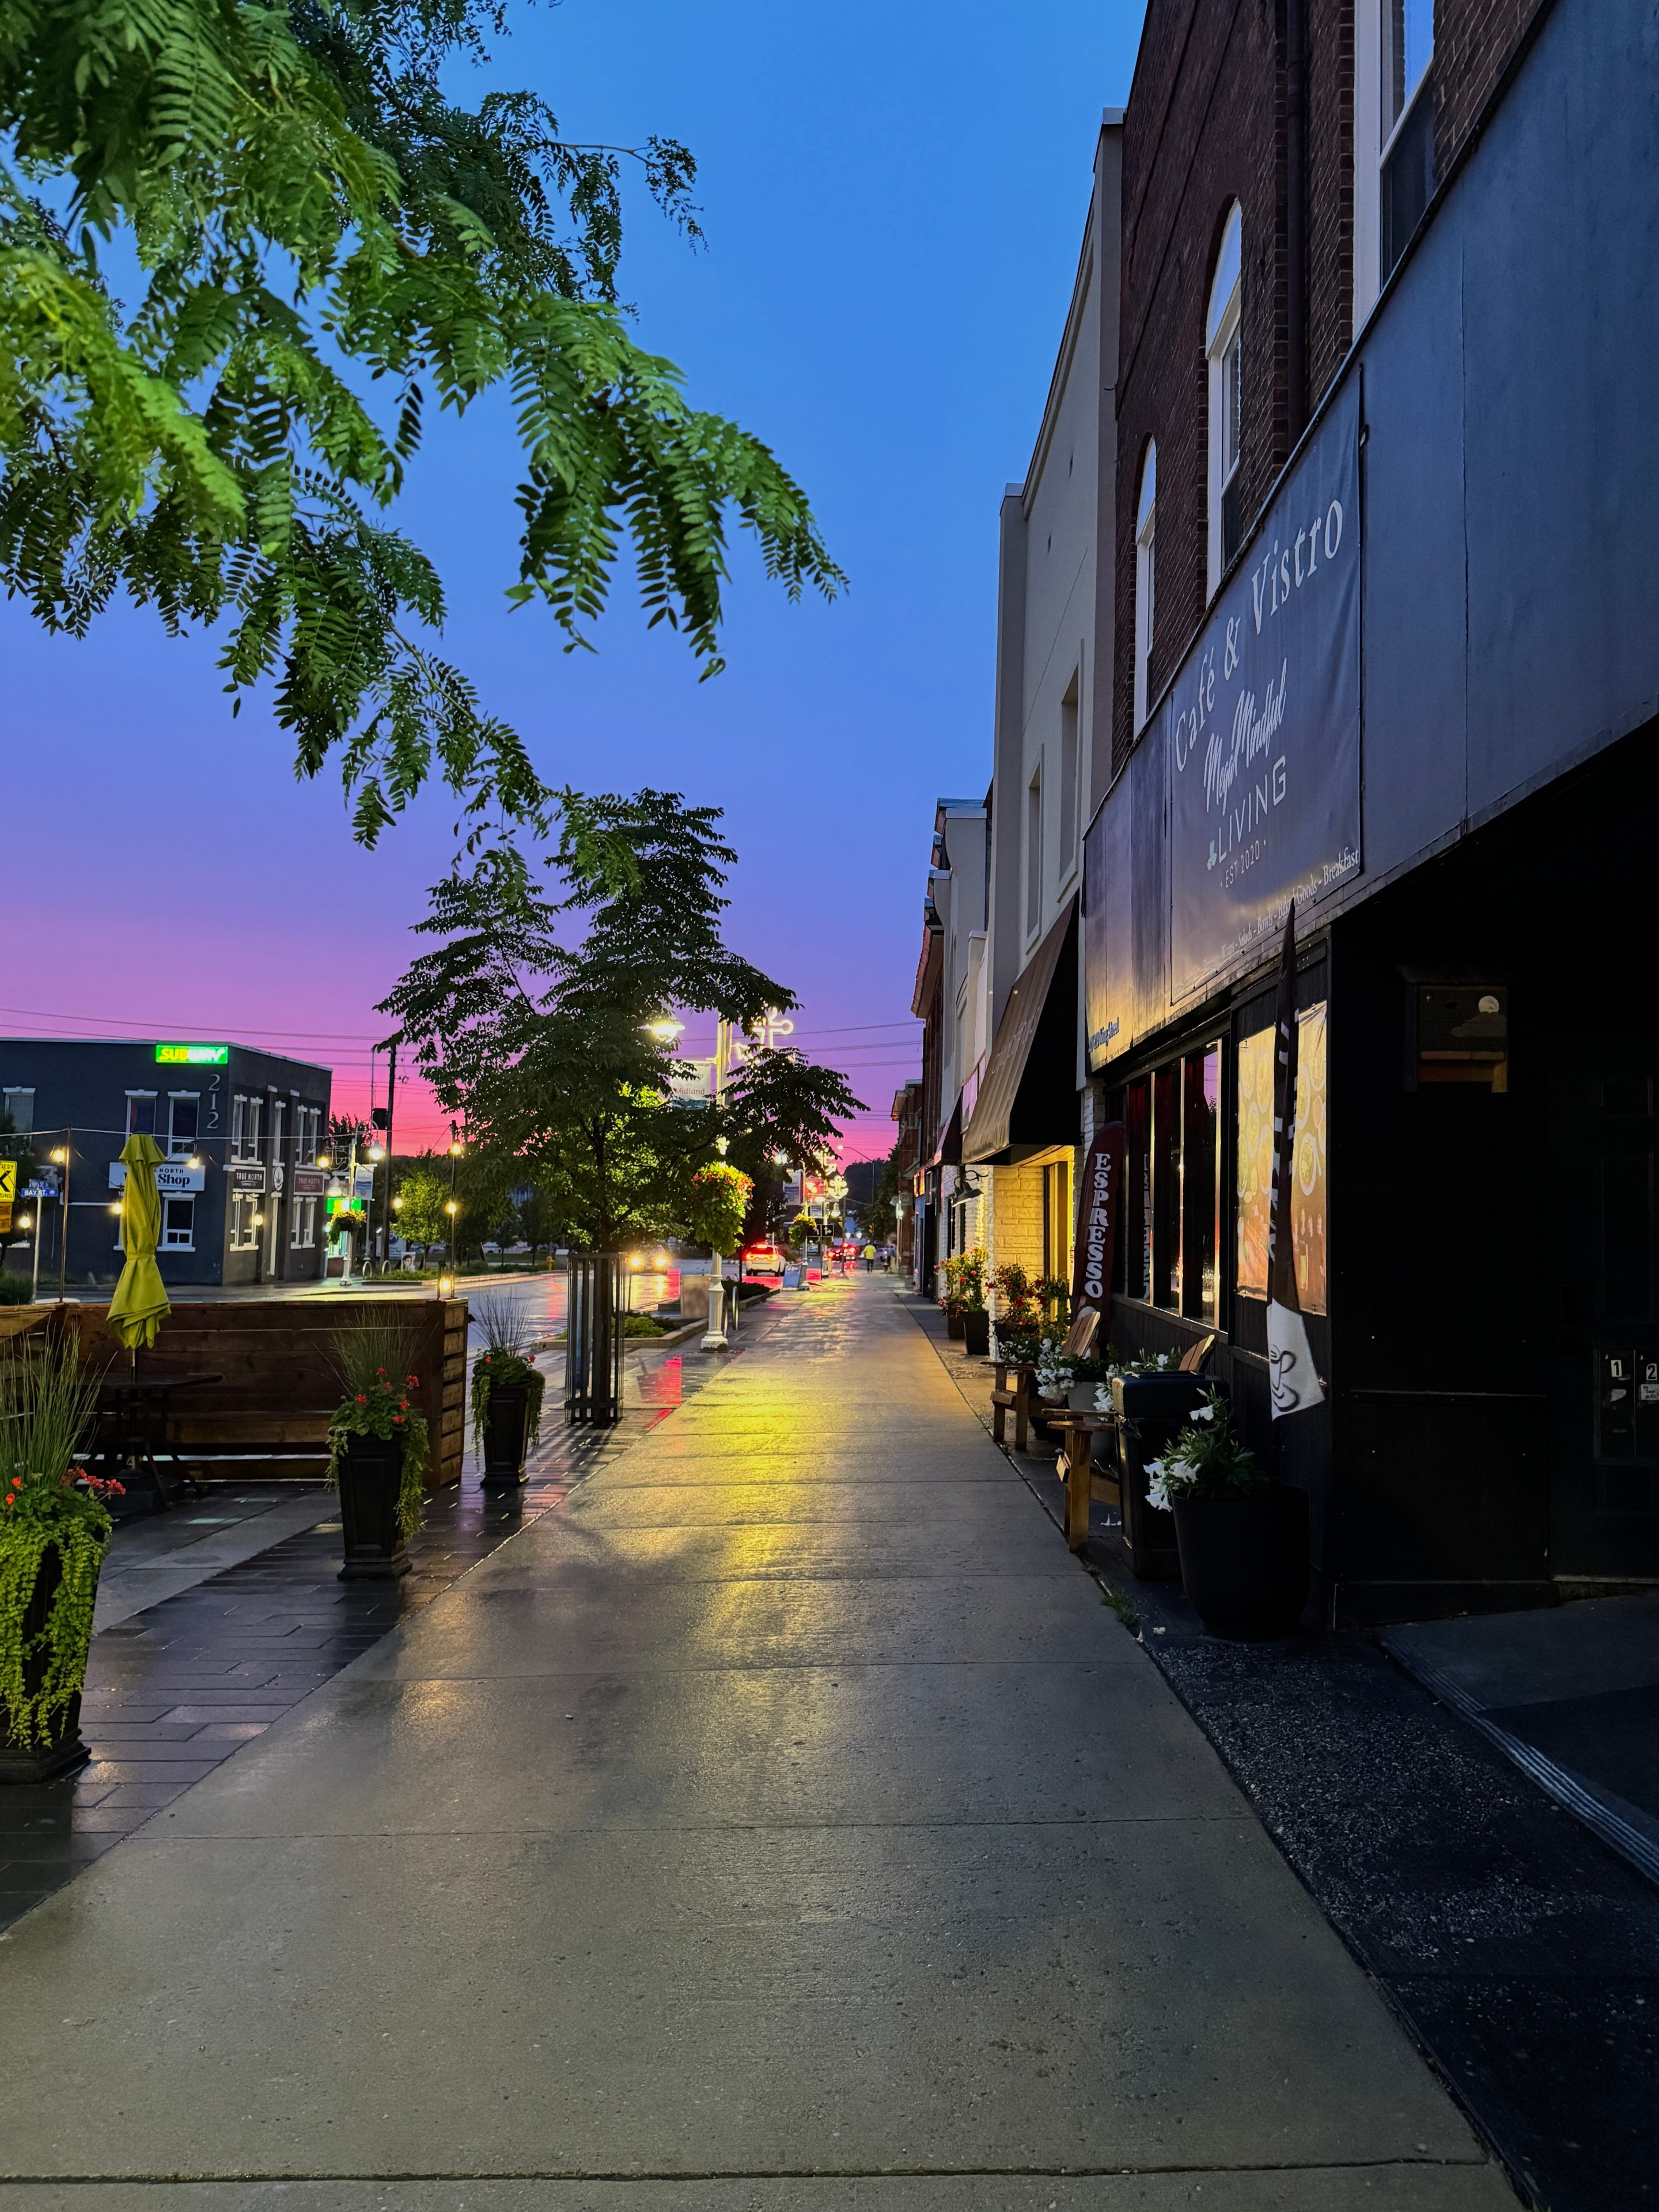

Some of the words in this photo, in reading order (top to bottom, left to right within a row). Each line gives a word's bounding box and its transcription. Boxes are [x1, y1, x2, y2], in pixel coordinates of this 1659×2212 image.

[1176, 646, 1215, 772] Café
[1224, 616, 1241, 681] &
[1251, 499, 1343, 635] Vistro
[1218, 755, 1286, 864] LIVING
[1225, 861, 1238, 889] EST
[1241, 840, 1260, 874] 2020
[1257, 908, 1273, 935] Bowls
[1297, 874, 1317, 905] Goods
[1323, 846, 1359, 887] Breakfast
[158, 1173, 191, 1188] Shop
[236, 1172, 247, 1180] TRUE
[248, 1173, 263, 1181] NORTH
[1084, 1153, 1111, 1298] ESPRESSO
[1647, 1364, 1657, 1380] 2
